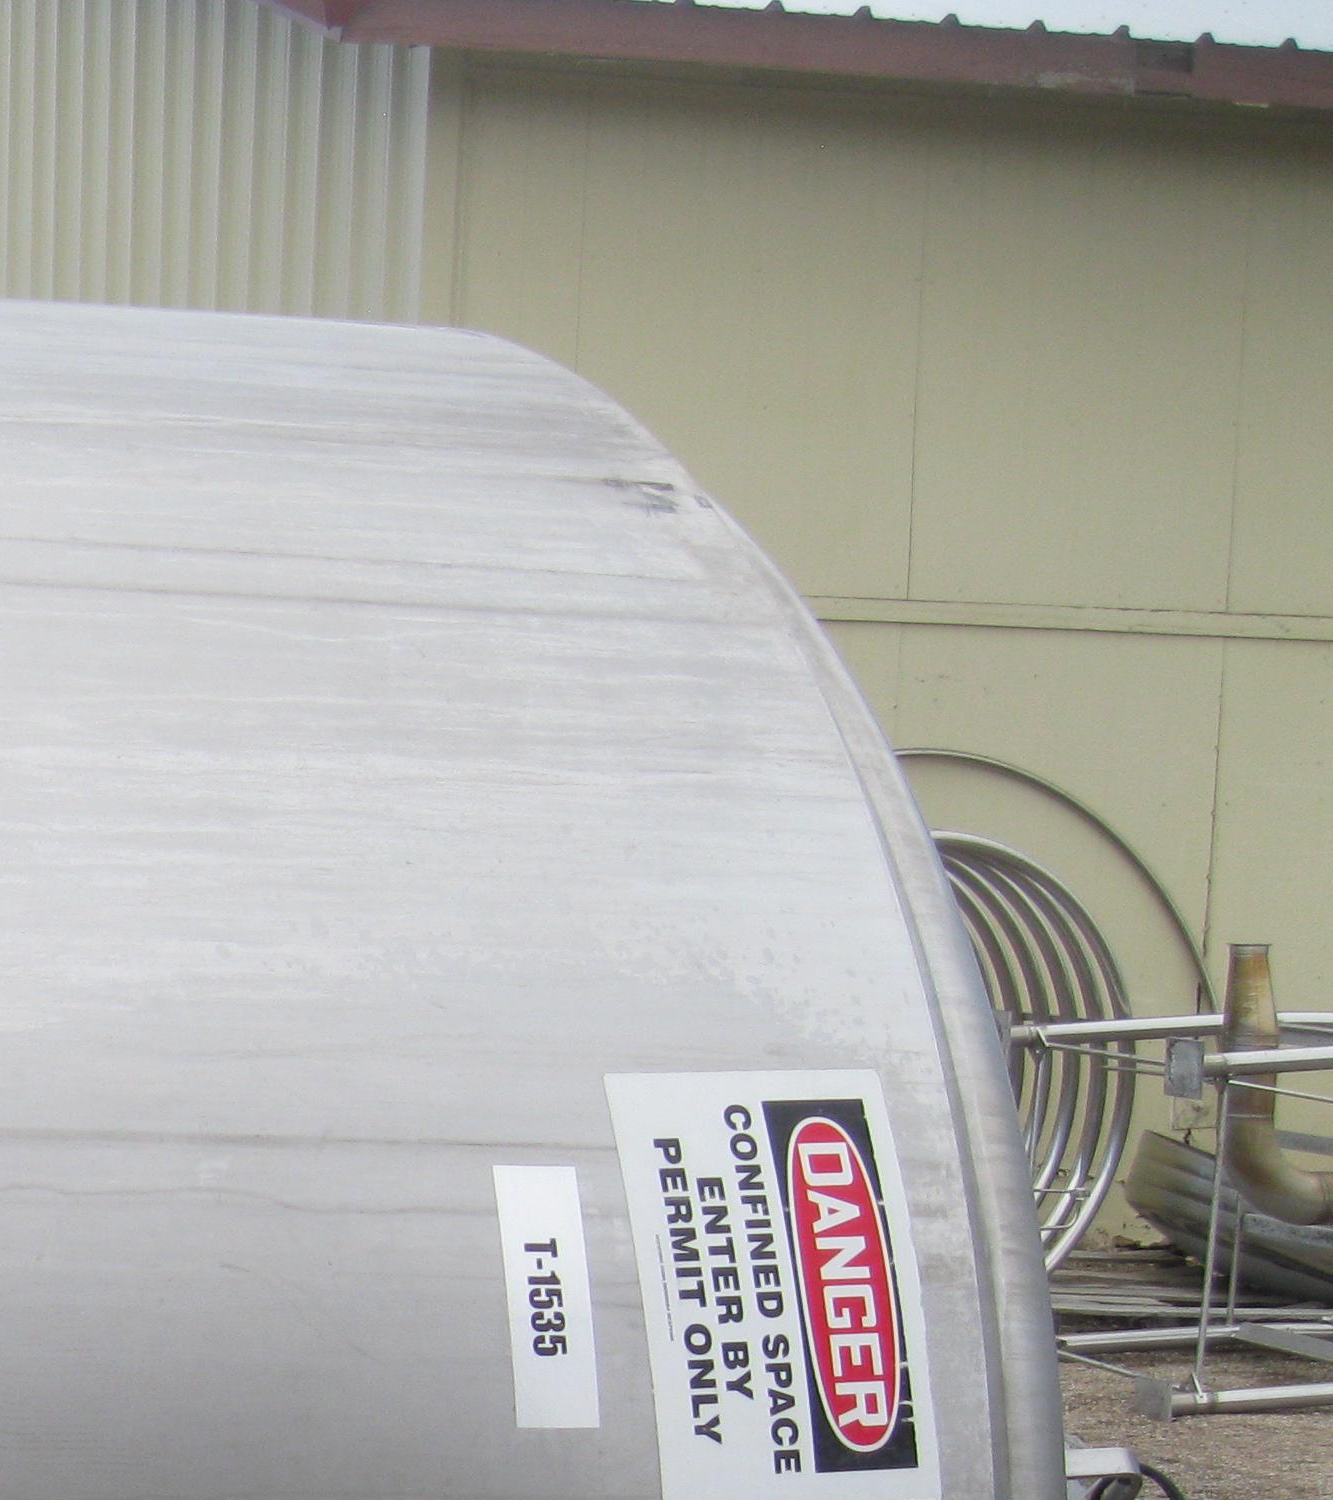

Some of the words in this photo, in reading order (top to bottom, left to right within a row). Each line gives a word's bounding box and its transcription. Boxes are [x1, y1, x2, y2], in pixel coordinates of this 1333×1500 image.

[524, 1238, 568, 1357] T-1535
[653, 1137, 707, 1308] PERMIT
[684, 1323, 723, 1445] ONLY
[696, 1177, 744, 1324] ENTER
[721, 1341, 754, 1401] BY
[723, 1104, 784, 1319] CONFINED
[761, 1333, 802, 1474] SPACE
[797, 1142, 888, 1428] DANGER
